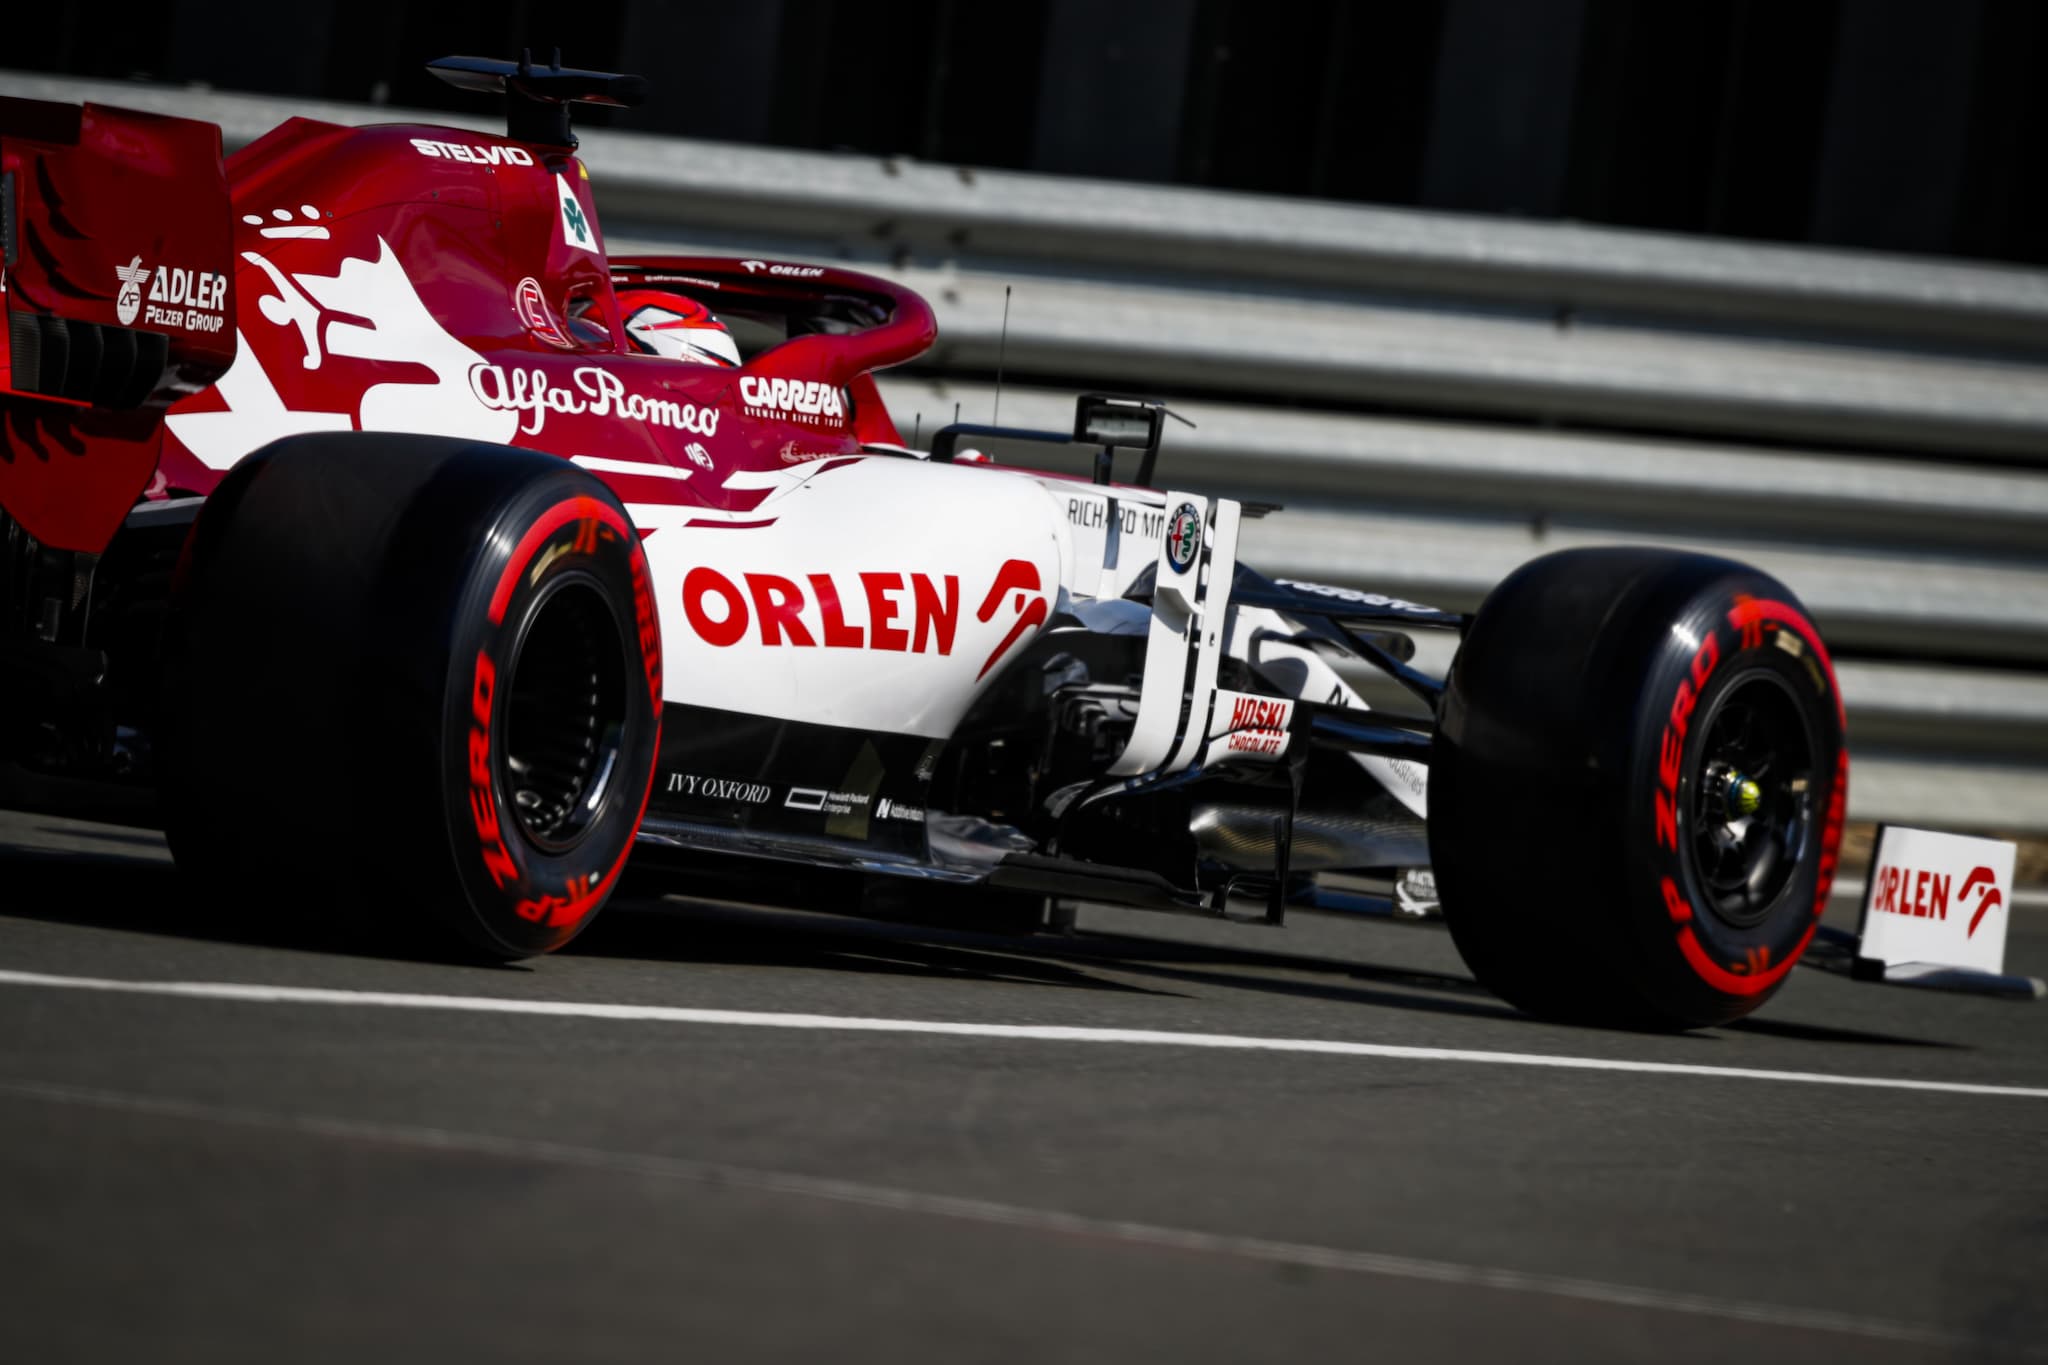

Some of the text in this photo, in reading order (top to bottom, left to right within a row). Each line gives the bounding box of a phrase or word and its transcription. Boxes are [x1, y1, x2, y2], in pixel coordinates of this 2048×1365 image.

[409, 138, 534, 166] STELVIO
[148, 265, 227, 311] ADLER
[769, 264, 824, 277] ORLEN
[144, 305, 224, 333] PELZER GROUP
[469, 363, 719, 437] Alfa Romeo
[739, 376, 843, 418] CARRERA
[682, 566, 959, 656] ORLEN
[1228, 733, 1281, 755] CHOCOLATE
[1655, 630, 1721, 853] ZERO
[468, 650, 520, 890] ZERO
[667, 773, 771, 804] IVY OXFORD
[1874, 865, 1951, 921] ORLEN
